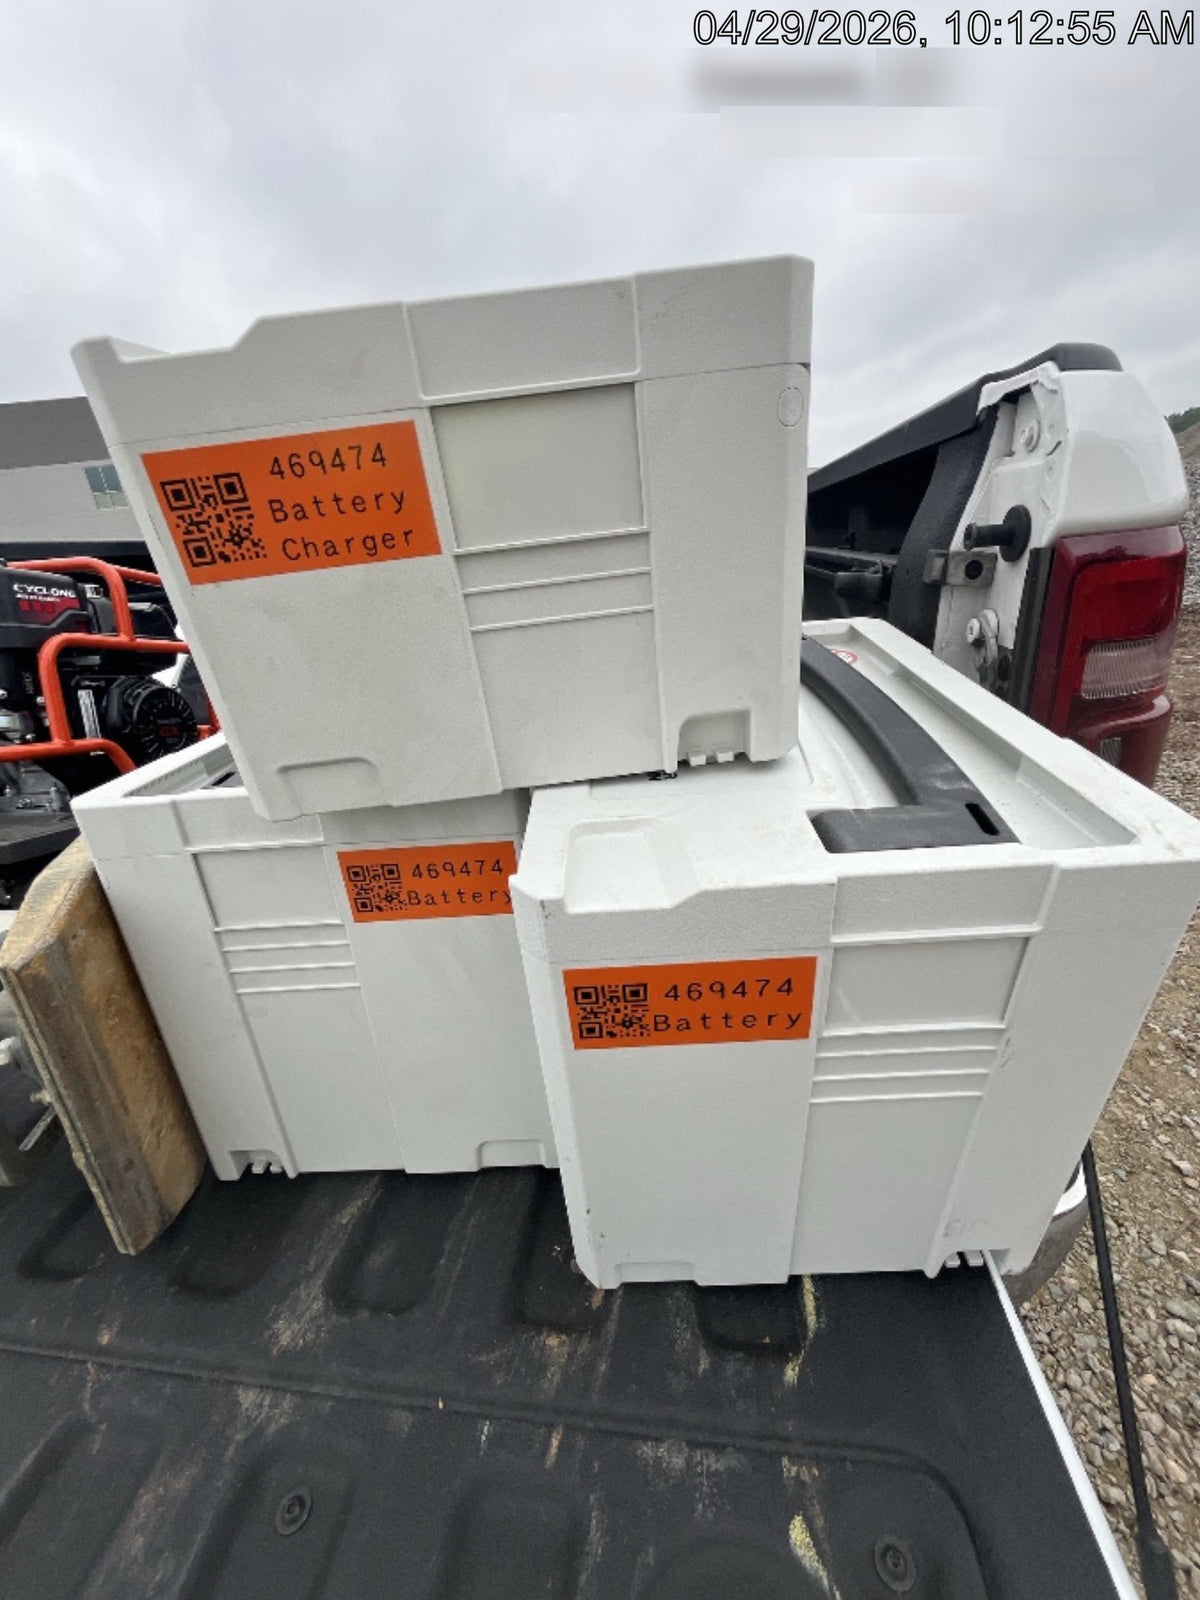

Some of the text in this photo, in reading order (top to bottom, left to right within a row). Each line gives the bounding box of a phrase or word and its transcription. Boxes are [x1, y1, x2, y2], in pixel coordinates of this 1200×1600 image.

[269, 442, 387, 480] 469474
[267, 490, 405, 524] Battery
[281, 529, 414, 561] Charger
[411, 858, 503, 879] 469474
[664, 977, 794, 1001] 469474
[653, 1011, 803, 1032] Battery
